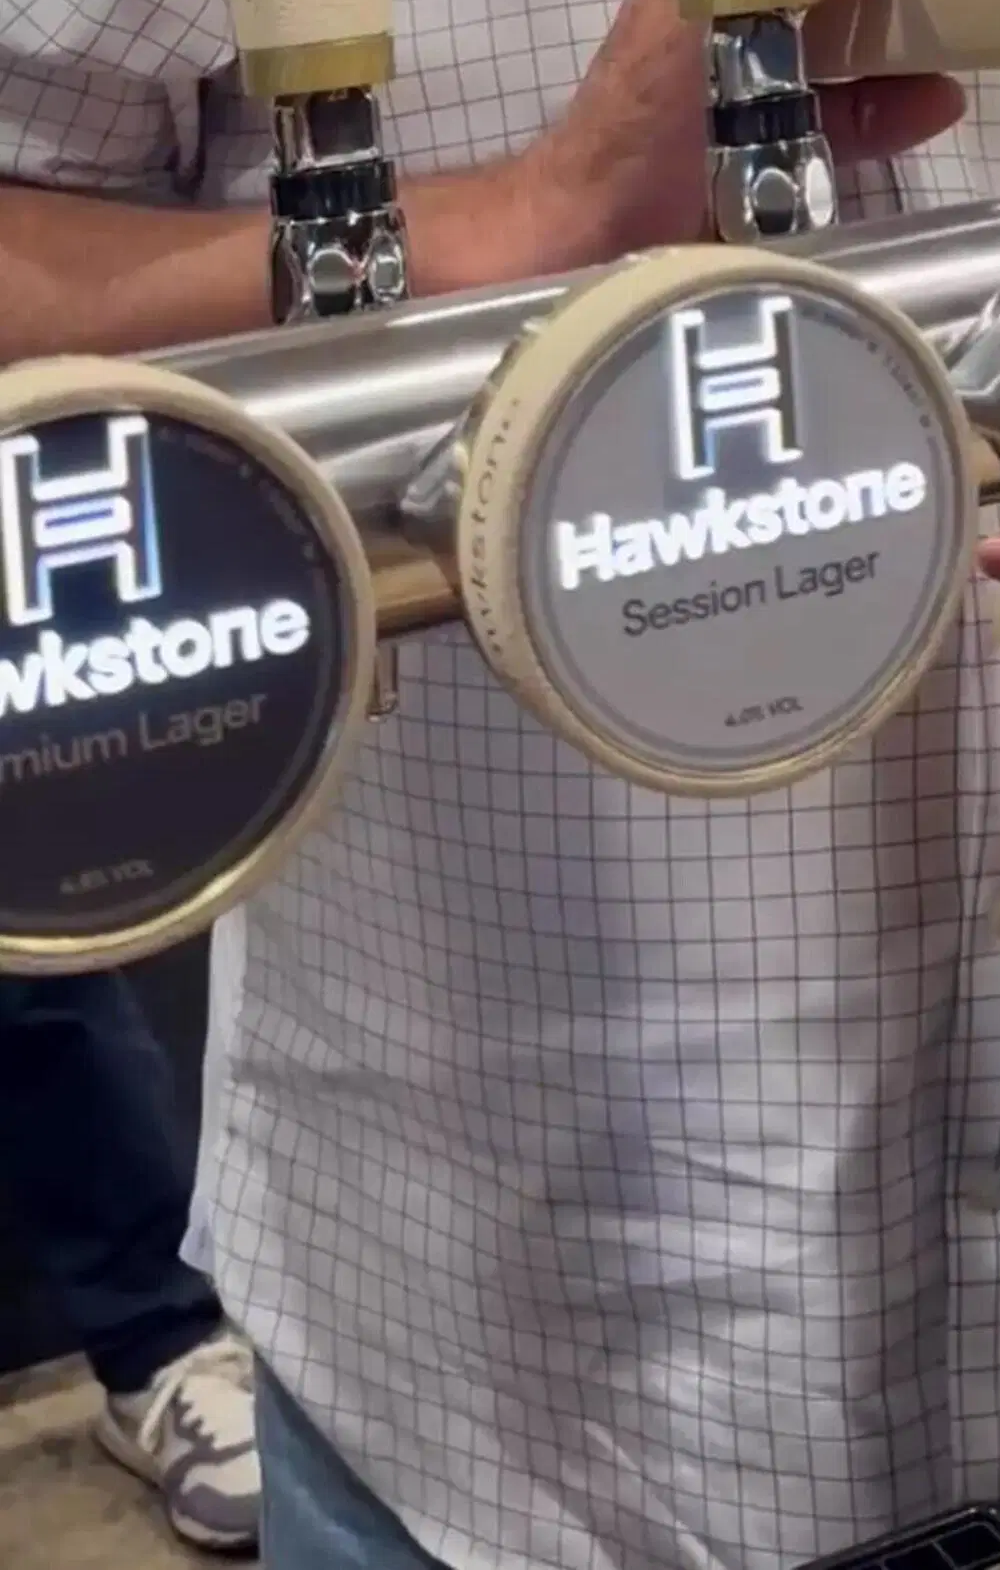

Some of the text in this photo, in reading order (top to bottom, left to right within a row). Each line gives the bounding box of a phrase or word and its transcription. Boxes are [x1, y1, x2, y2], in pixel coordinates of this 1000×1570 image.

[555, 461, 927, 591] Hawkstone
[621, 550, 880, 637] Session Lager
[137, 693, 268, 751] Lager
